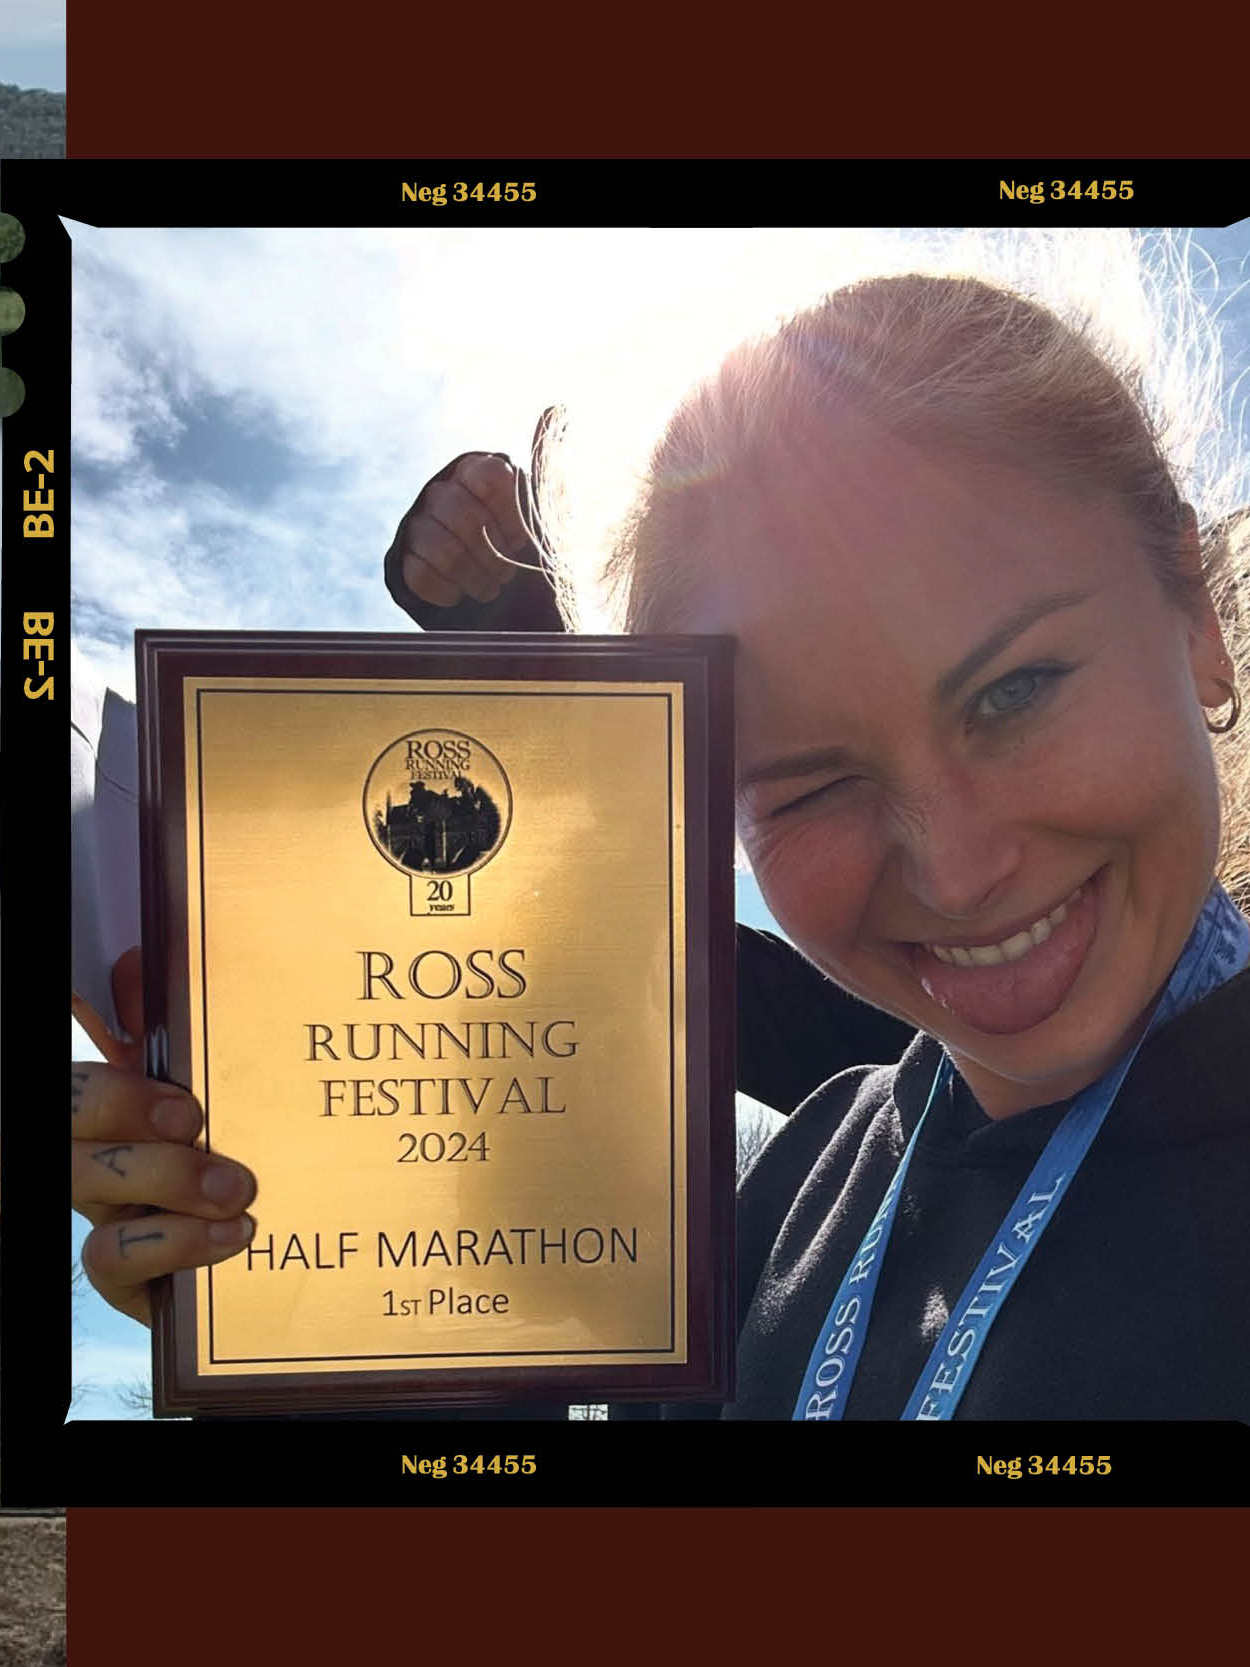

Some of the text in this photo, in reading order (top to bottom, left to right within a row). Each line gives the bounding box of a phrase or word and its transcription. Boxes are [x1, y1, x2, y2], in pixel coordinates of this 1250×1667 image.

[406, 740, 470, 759] ROSS
[406, 759, 470, 770] RUNNING
[427, 880, 453, 901] 20
[429, 903, 455, 912] years
[357, 949, 527, 1000] ROSS
[304, 1020, 581, 1061] RUNNING
[319, 1076, 567, 1118] FESTIVAL
[397, 1131, 491, 1163] 2024
[246, 1226, 638, 1272] HALF MARATHON
[429, 1287, 510, 1316] Place
[917, 1172, 1067, 1420] FESTIVAL
[806, 1295, 862, 1420] ROSS
